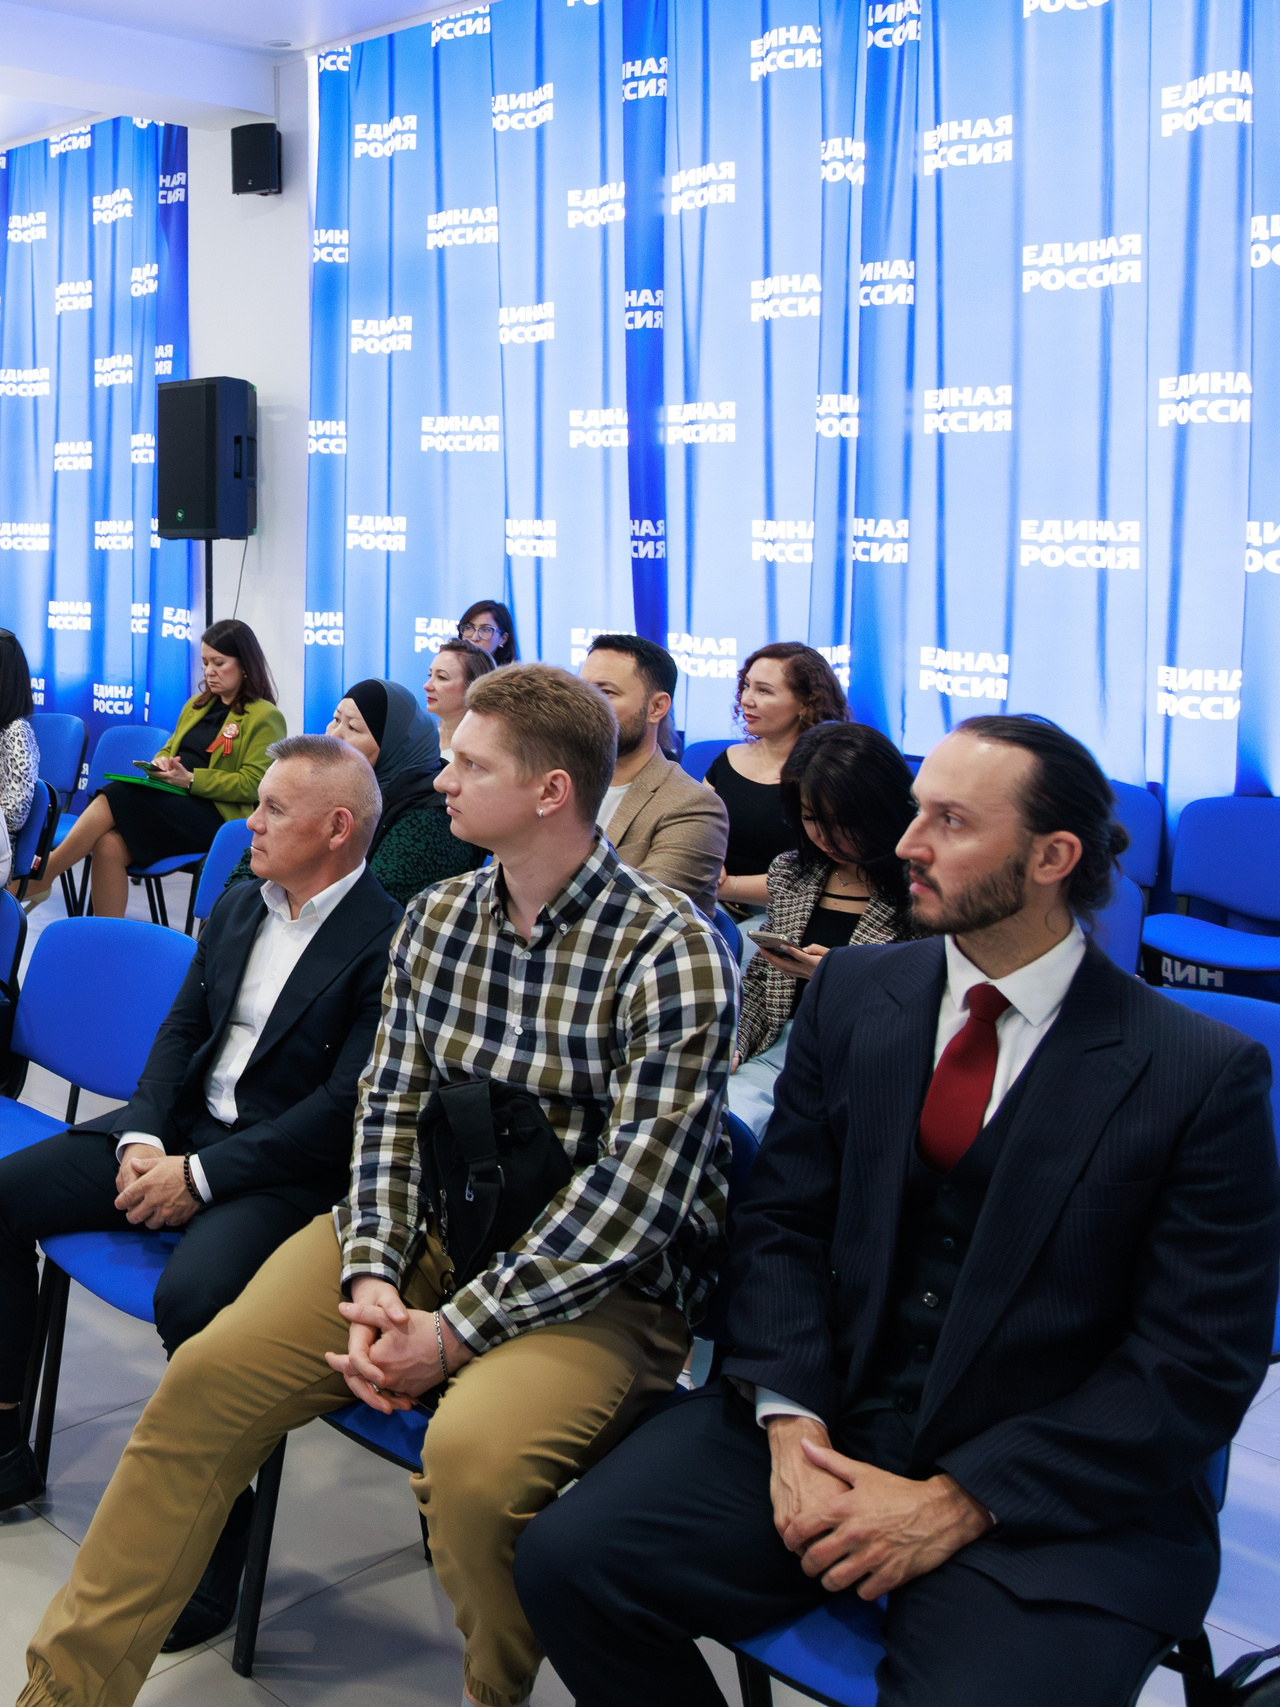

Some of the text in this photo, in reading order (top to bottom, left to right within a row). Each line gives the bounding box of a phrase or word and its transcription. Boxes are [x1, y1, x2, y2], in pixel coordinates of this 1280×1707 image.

[1161, 70, 1253, 109] ЕДИНА
[1161, 98, 1252, 137] РОССИ
[159, 172, 186, 188] НАЯ
[158, 188, 185, 204] СИЯ
[1023, 234, 1142, 267] ЕДИНАЯ
[1023, 260, 1141, 293] РОССИЯ
[624, 288, 664, 309] НАЯ
[624, 309, 664, 331] СИЯ
[499, 321, 555, 344] ОССИЯ
[1159, 372, 1252, 400] ЕДИНА
[1158, 399, 1250, 427] РОССИ
[421, 415, 499, 434] ЕДИНАЯ
[421, 434, 499, 452] РОССИЯ
[629, 519, 665, 538] НАЯ
[1021, 519, 1140, 543] ЕДИНАЯ
[629, 540, 666, 559] СИЯ
[1020, 545, 1140, 570] РОССИЯ
[414, 617, 461, 639] ЕДИ
[94, 684, 132, 698] ЕДИНА
[93, 698, 133, 715] РОССИ
[1157, 691, 1240, 720] РОССИ
[1161, 956, 1224, 988] ДИН
